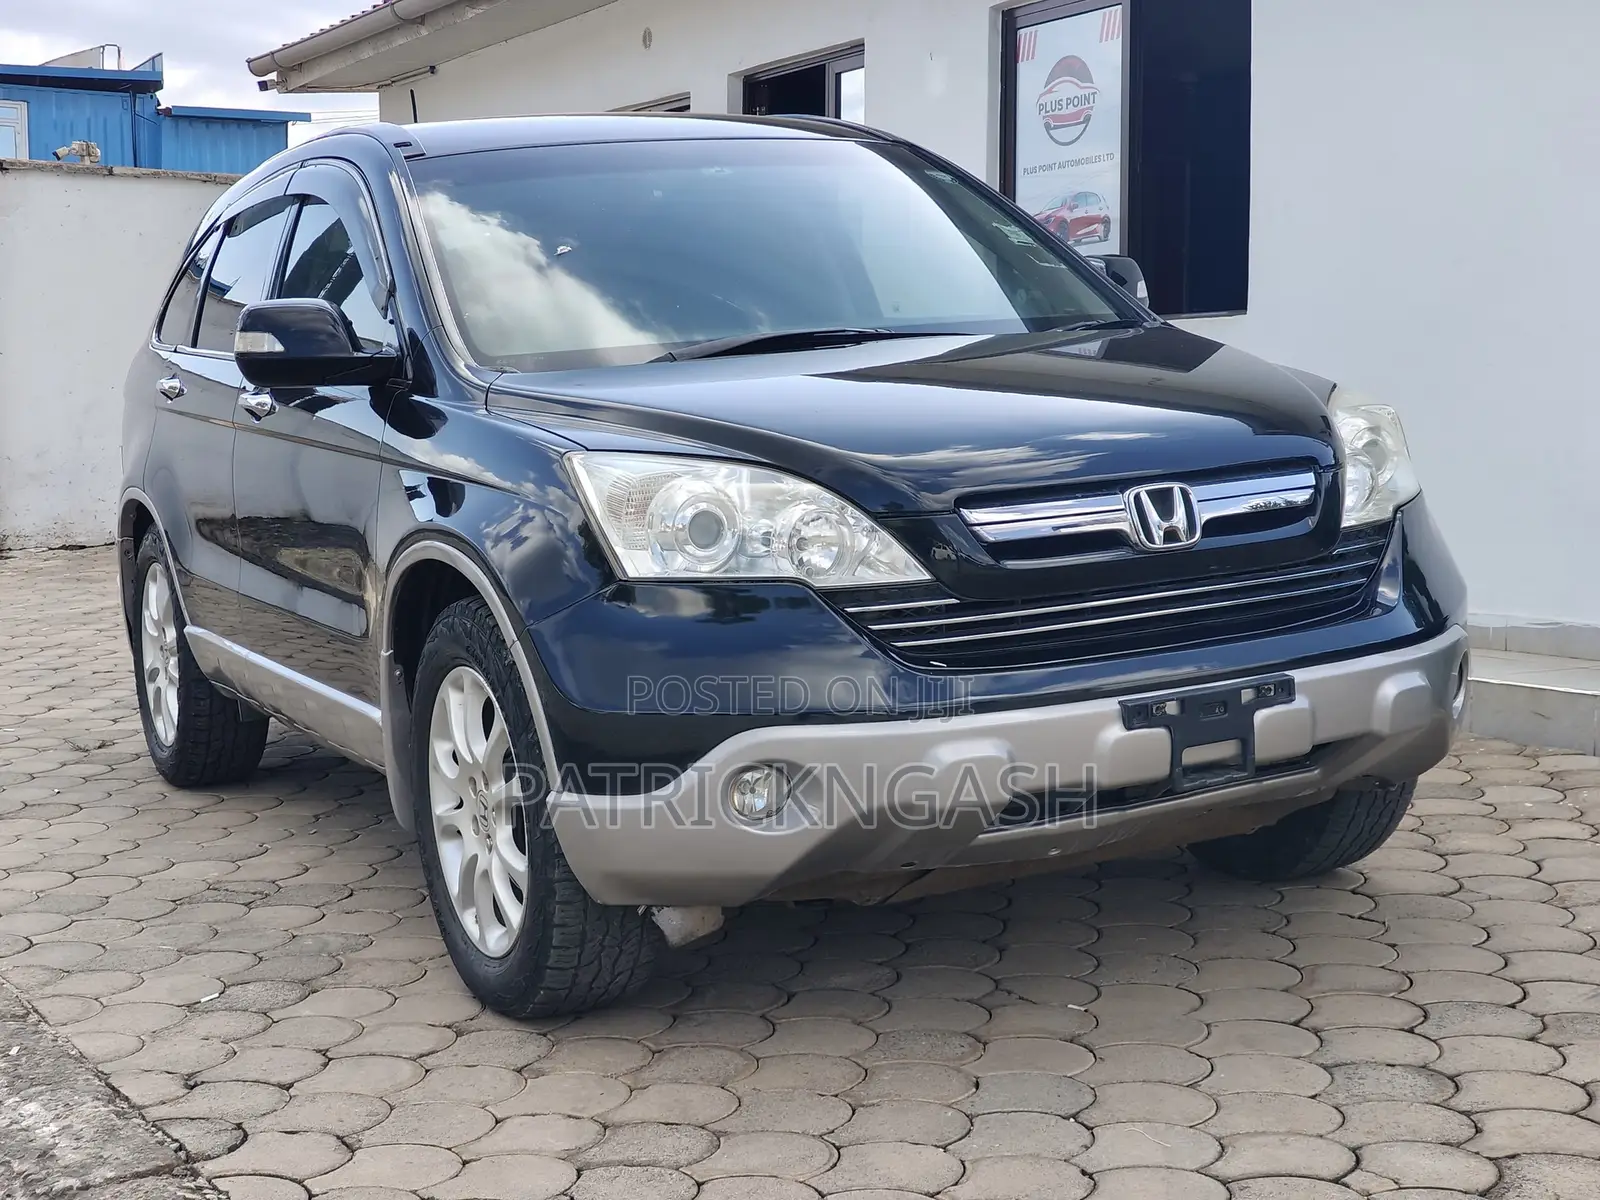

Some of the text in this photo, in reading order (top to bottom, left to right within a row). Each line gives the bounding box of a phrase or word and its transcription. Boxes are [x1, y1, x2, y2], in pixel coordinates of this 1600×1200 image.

[1038, 91, 1097, 115] PLUS POINT
[1022, 152, 1115, 176] PLUS POINT AUTOMOBILES LTD
